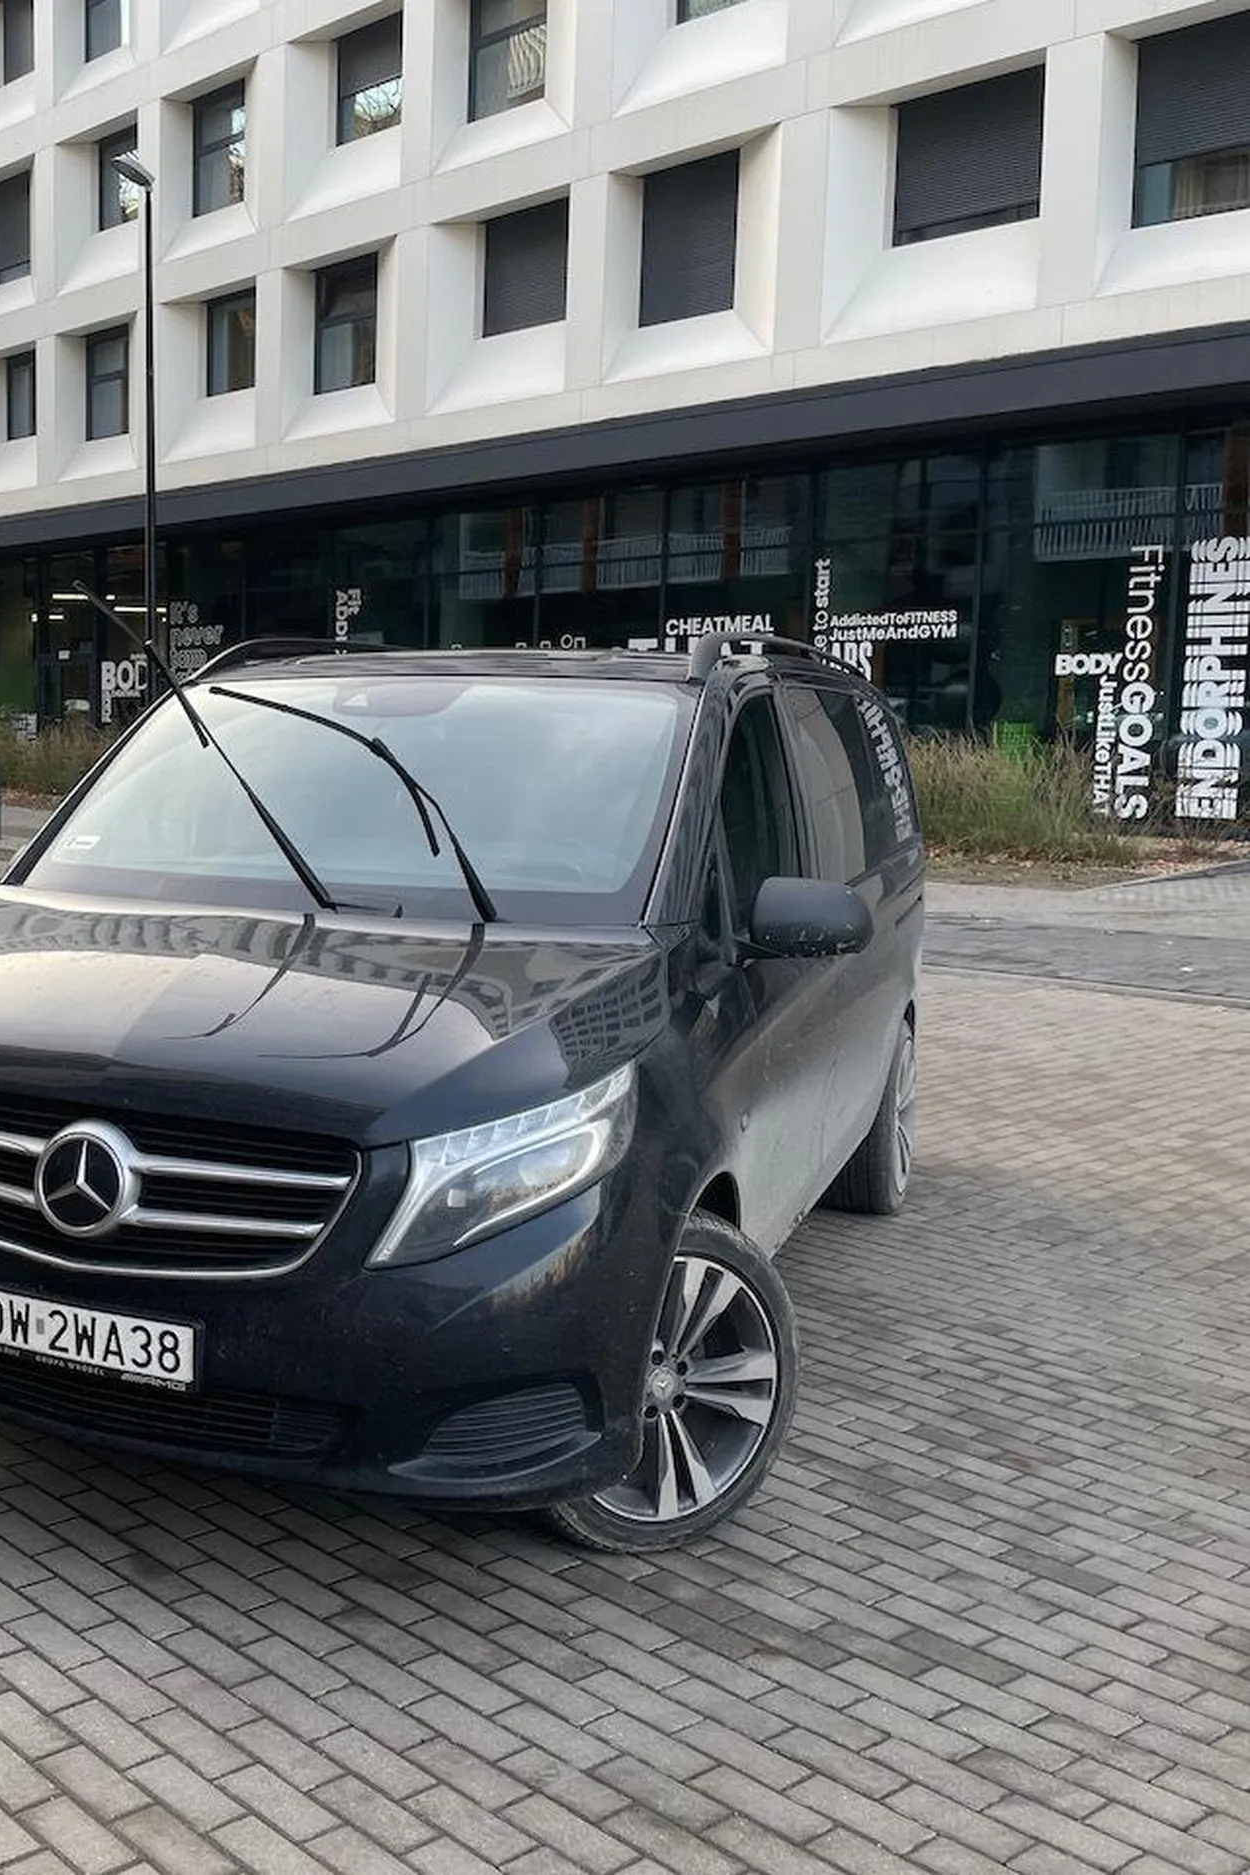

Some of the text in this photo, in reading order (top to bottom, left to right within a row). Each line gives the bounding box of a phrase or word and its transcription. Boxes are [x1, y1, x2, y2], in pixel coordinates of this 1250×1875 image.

[814, 558, 831, 608] start
[665, 614, 775, 637] CHEATMEAL
[829, 624, 957, 642] JustMeAndGYM
[830, 610, 958, 628] AddictedToFITNESS
[1055, 652, 1124, 676] BODY
[1114, 544, 1163, 820] FitnessGOALS
[1174, 536, 1250, 820] ENDORPHINES
[49, 1310, 181, 1373] 2WA38
